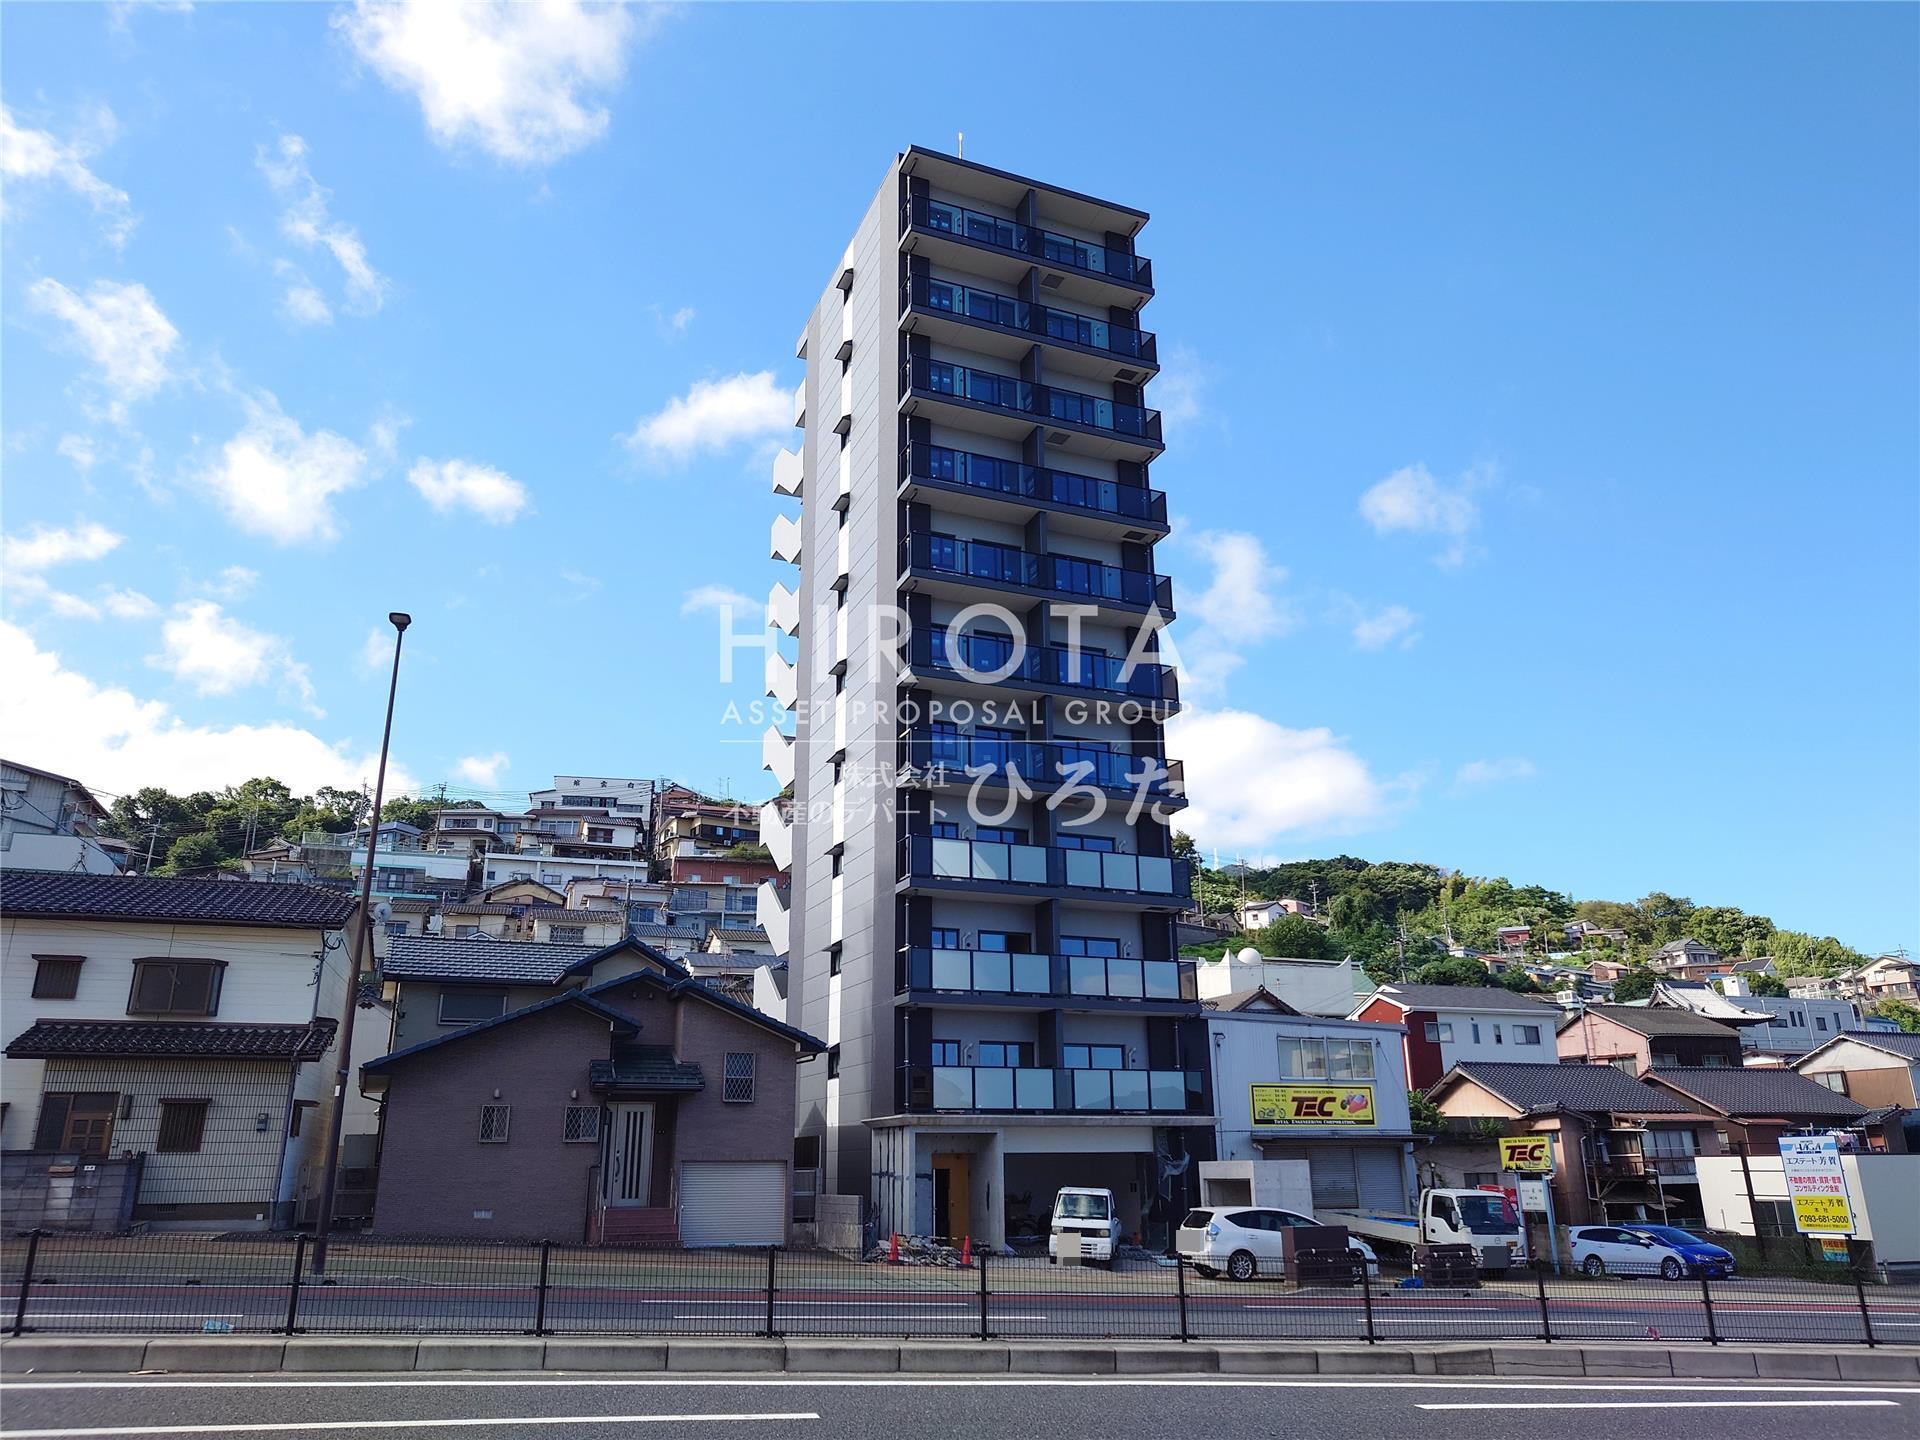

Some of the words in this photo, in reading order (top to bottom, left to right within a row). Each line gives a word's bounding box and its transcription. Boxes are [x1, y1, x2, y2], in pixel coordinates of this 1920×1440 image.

[1291, 1096, 1337, 1117] TEC
[1505, 1144, 1545, 1161] TEC
[1786, 1157, 1817, 1165] エステート
[1797, 1199, 1826, 1207] エステート
[1804, 1214, 1849, 1224] 093-681-5000
